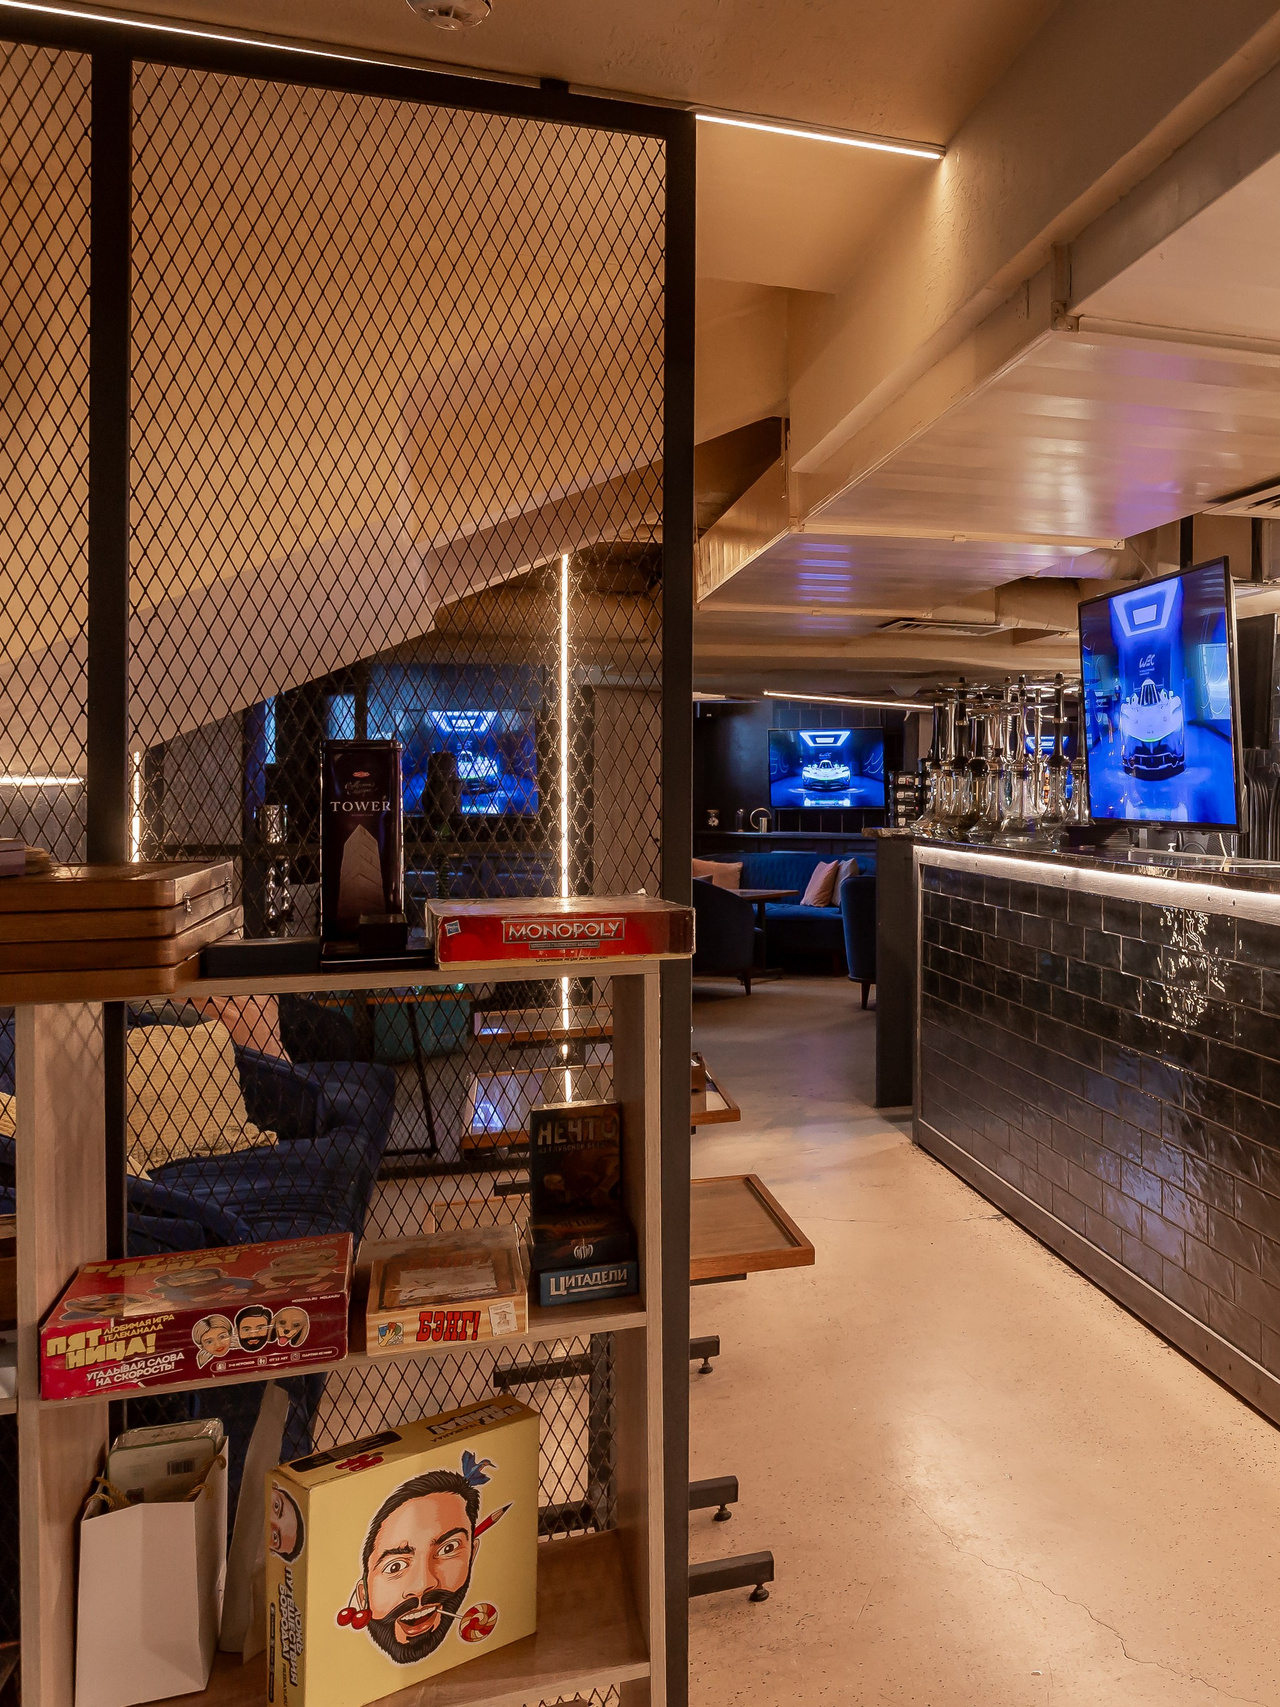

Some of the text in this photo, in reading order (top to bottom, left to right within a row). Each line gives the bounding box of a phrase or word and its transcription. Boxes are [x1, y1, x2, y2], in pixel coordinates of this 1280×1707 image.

[329, 801, 391, 812] TOWER
[508, 921, 621, 940] MONOPOLY
[537, 1116, 618, 1146] НЕЧТО
[550, 1268, 628, 1296] ЦИТАДЕЛИ
[103, 1313, 175, 1336] ЛЮБИМАЯ ИГРА
[103, 1323, 164, 1342] ТЕЛЕКАНАЛА
[416, 1310, 481, 1341] БЭНГ!
[46, 1328, 102, 1357] ПЯТ
[65, 1333, 156, 1370] НИЦА!
[86, 1352, 185, 1381] УГАДЫВАЙ СЛОВА
[95, 1362, 175, 1387] НА СКОРОСТЬ!
[278, 1583, 290, 1660] БОРОДА!
[284, 1566, 299, 1687] ПУТЕШЕСТВИЯ
[294, 1604, 304, 1656] ЛОЖЬ
